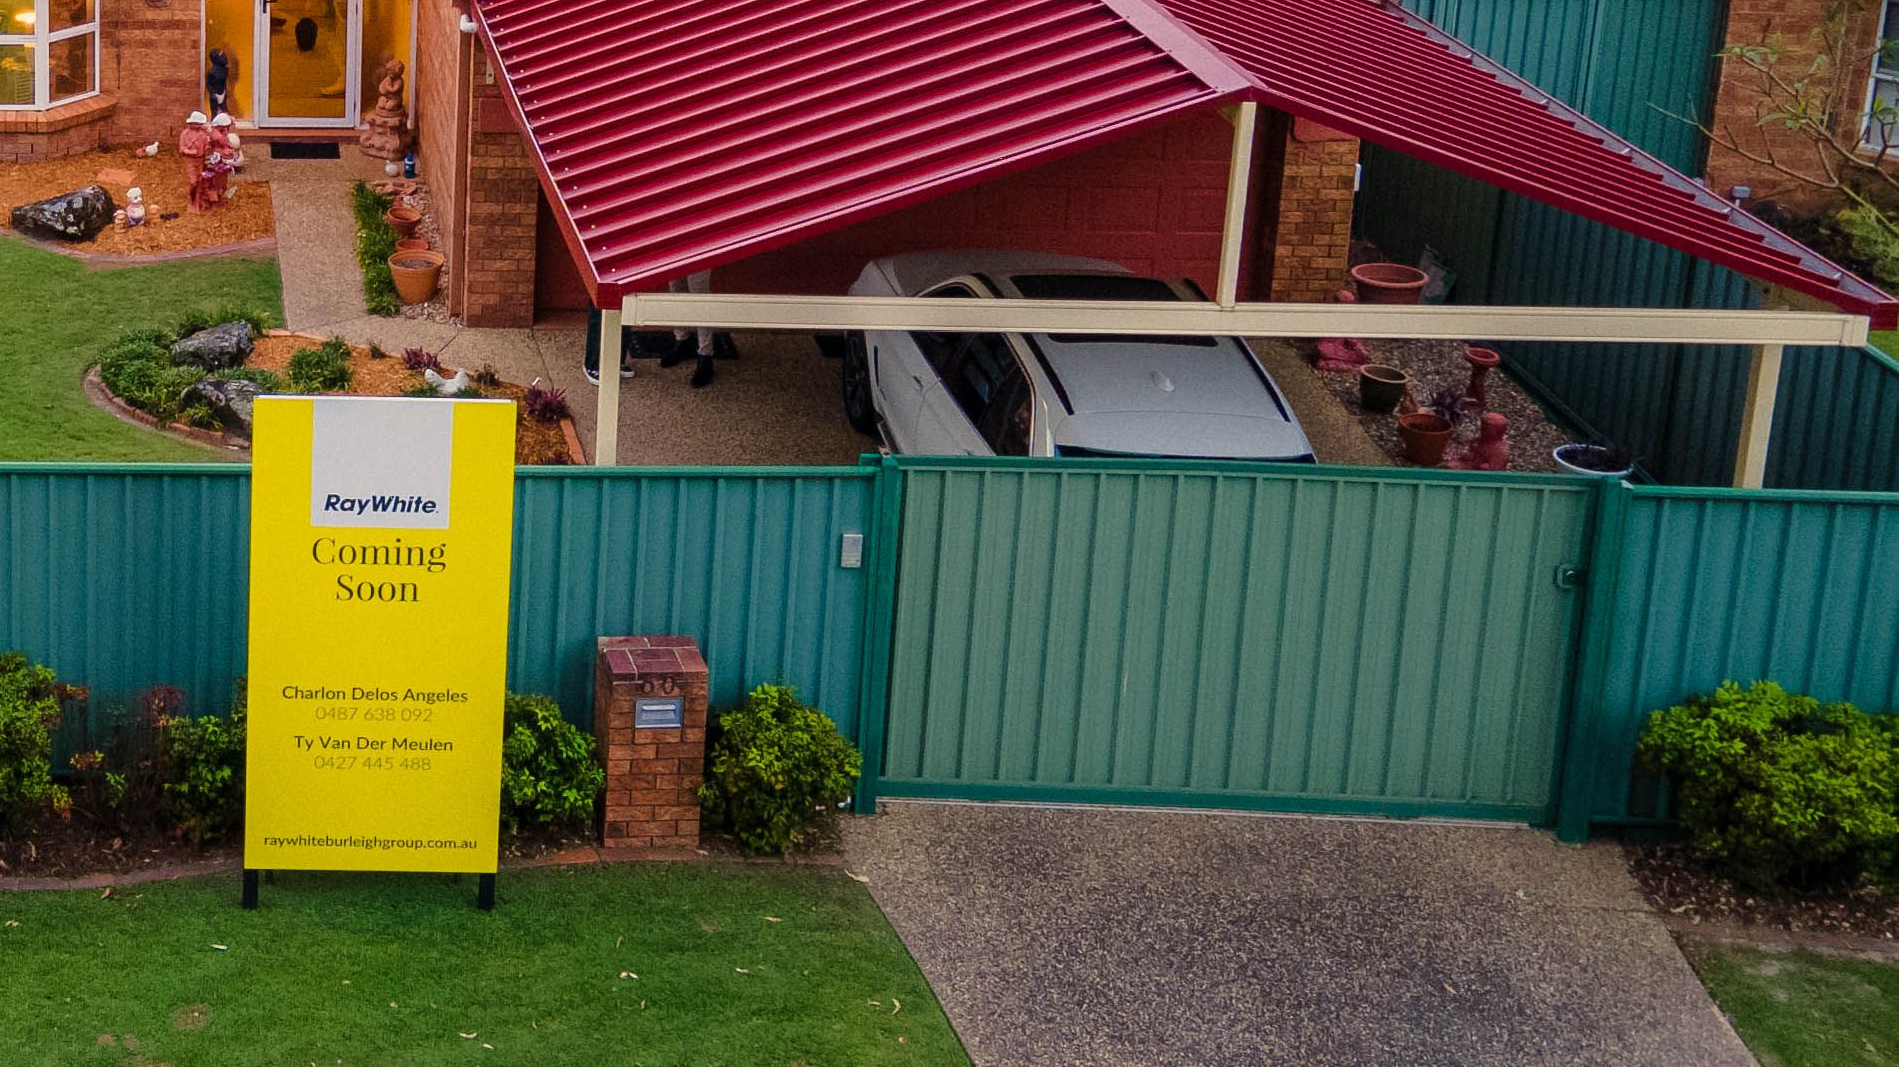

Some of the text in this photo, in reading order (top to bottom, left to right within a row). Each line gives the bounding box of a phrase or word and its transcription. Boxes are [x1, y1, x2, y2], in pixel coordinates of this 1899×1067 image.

[324, 493, 438, 516] RayWhite
[312, 537, 447, 573] Coming
[336, 574, 419, 602] Soon
[282, 685, 469, 705] Charlon Delos Angeles
[315, 706, 433, 723] 0487 638 092
[294, 735, 454, 752] Ty Van Der Meulen
[314, 755, 432, 771] 0427 445 488
[263, 834, 477, 850] raywhiteburleighgroup.com.au
